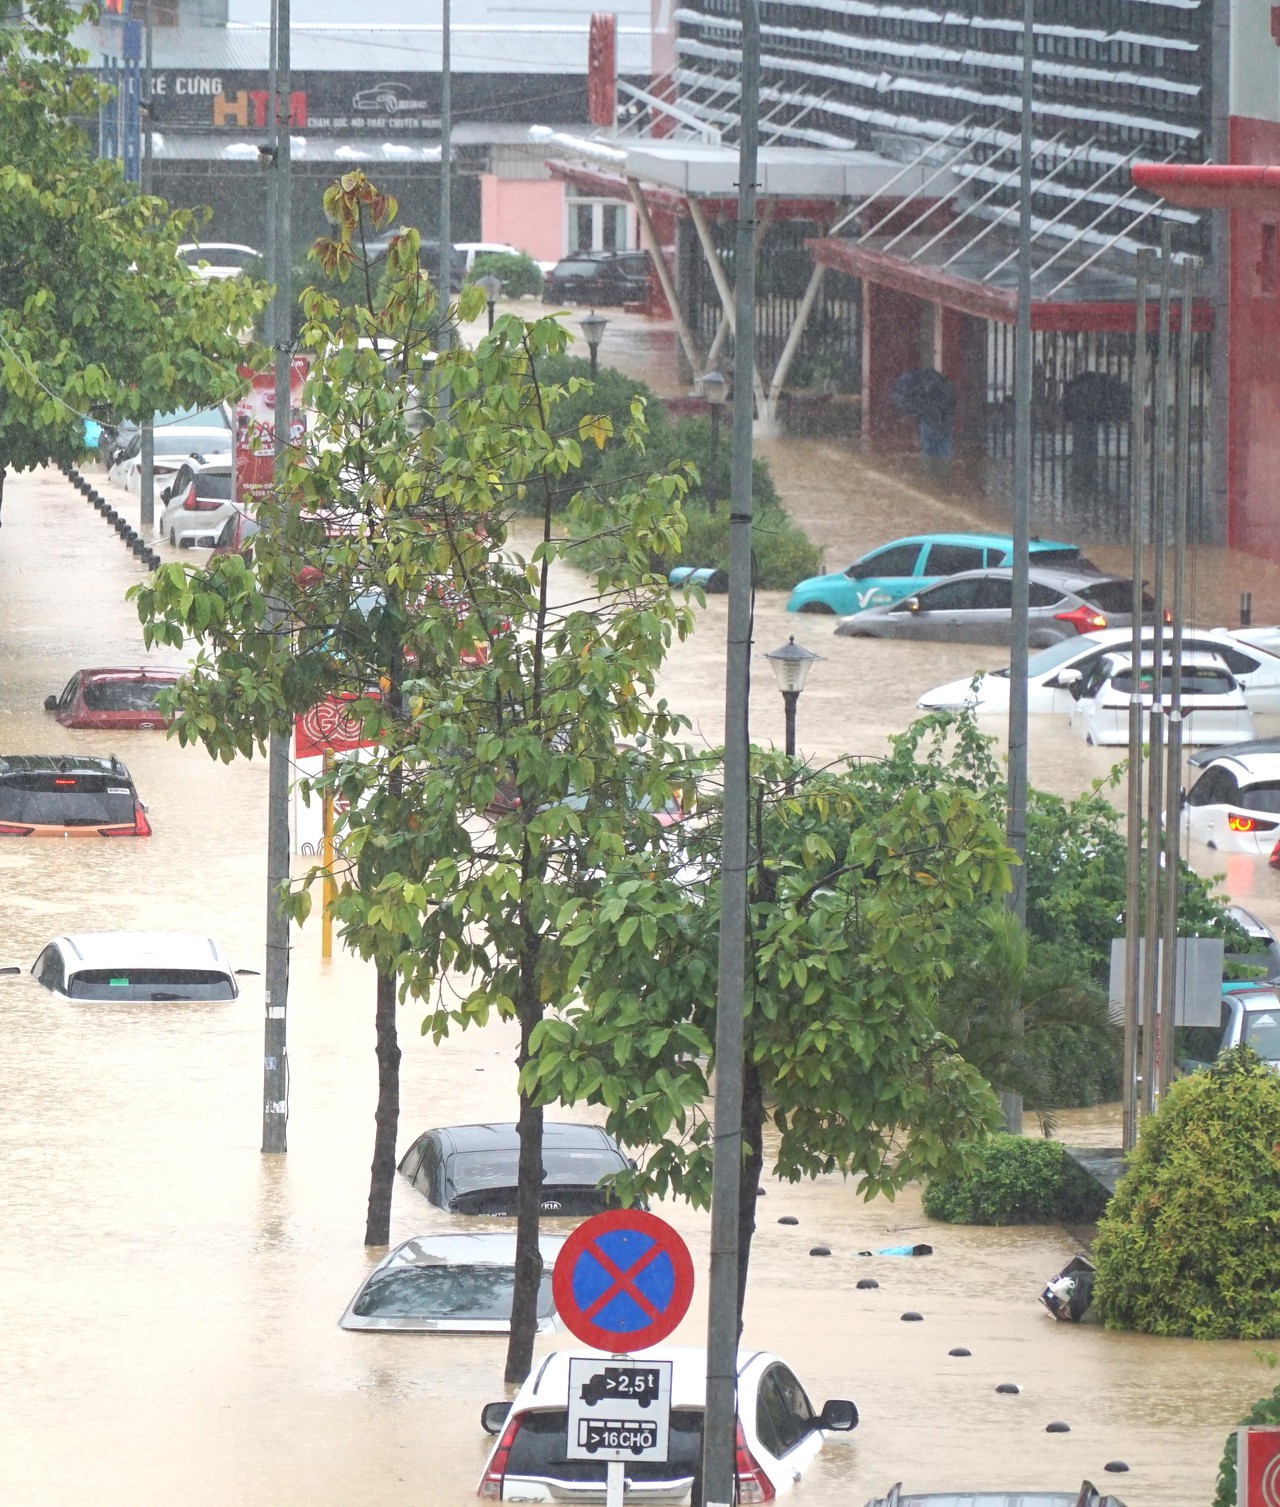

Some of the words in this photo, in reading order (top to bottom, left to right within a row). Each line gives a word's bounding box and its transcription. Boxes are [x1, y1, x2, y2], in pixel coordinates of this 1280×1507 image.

[175, 76, 223, 95] CƯNG
[303, 702, 365, 742] GO
[620, 1429, 652, 1447] CHỖ
